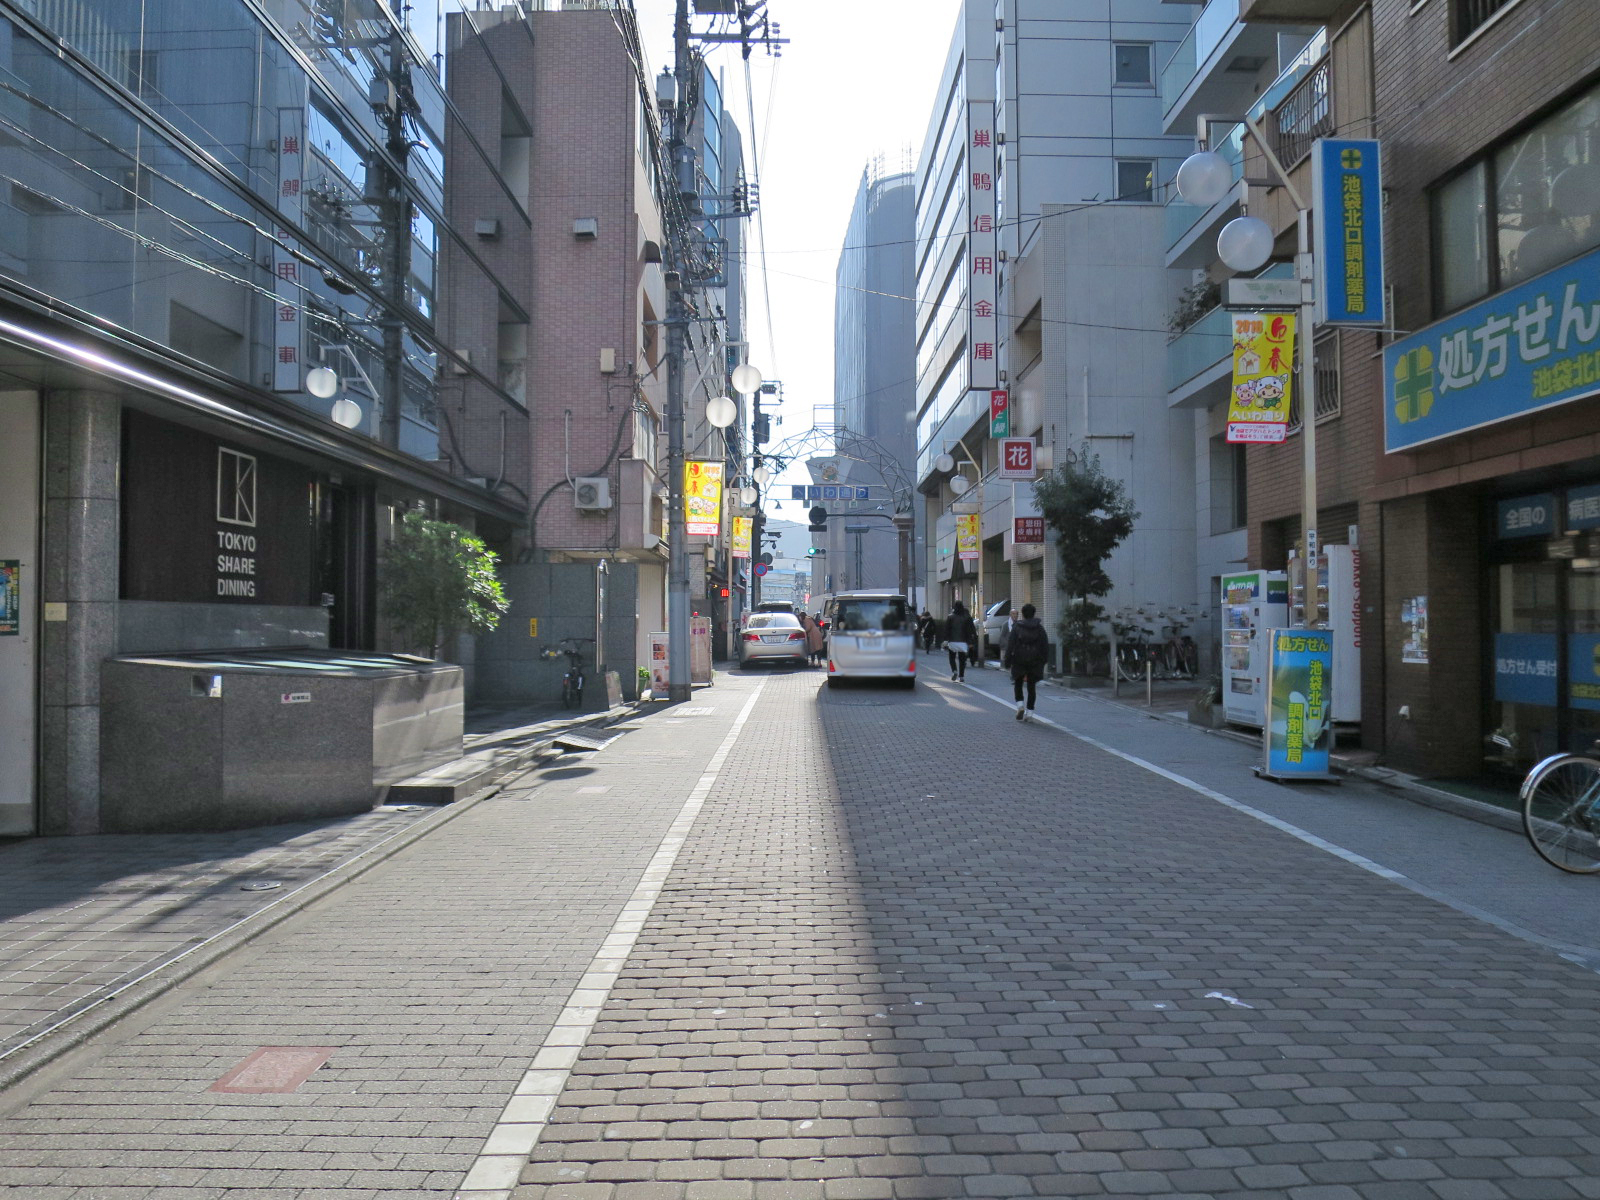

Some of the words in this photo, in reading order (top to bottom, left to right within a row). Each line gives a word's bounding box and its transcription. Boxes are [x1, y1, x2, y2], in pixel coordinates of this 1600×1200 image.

[972, 128, 993, 361] 巣鴨信用金庫
[1343, 174, 1364, 313] 池袋北口調剤薬局
[1264, 316, 1291, 374] 迎春
[1438, 282, 1600, 394] 処方せん
[993, 394, 1006, 434] 花と緑
[1231, 410, 1285, 421] へいわ通り
[1008, 446, 1029, 467] 花
[793, 486, 867, 498] へいわ通り
[1505, 506, 1546, 529] 全国の
[217, 531, 256, 552] TOKYO
[1308, 532, 1316, 566] 平和通り
[217, 555, 256, 575] SHARE
[217, 578, 255, 597] DINING
[1277, 635, 1329, 653] 処方せん
[1496, 658, 1557, 678] 処方せん受付
[1308, 659, 1323, 720] 池袋北口
[1286, 702, 1304, 763] 調剤薬局
